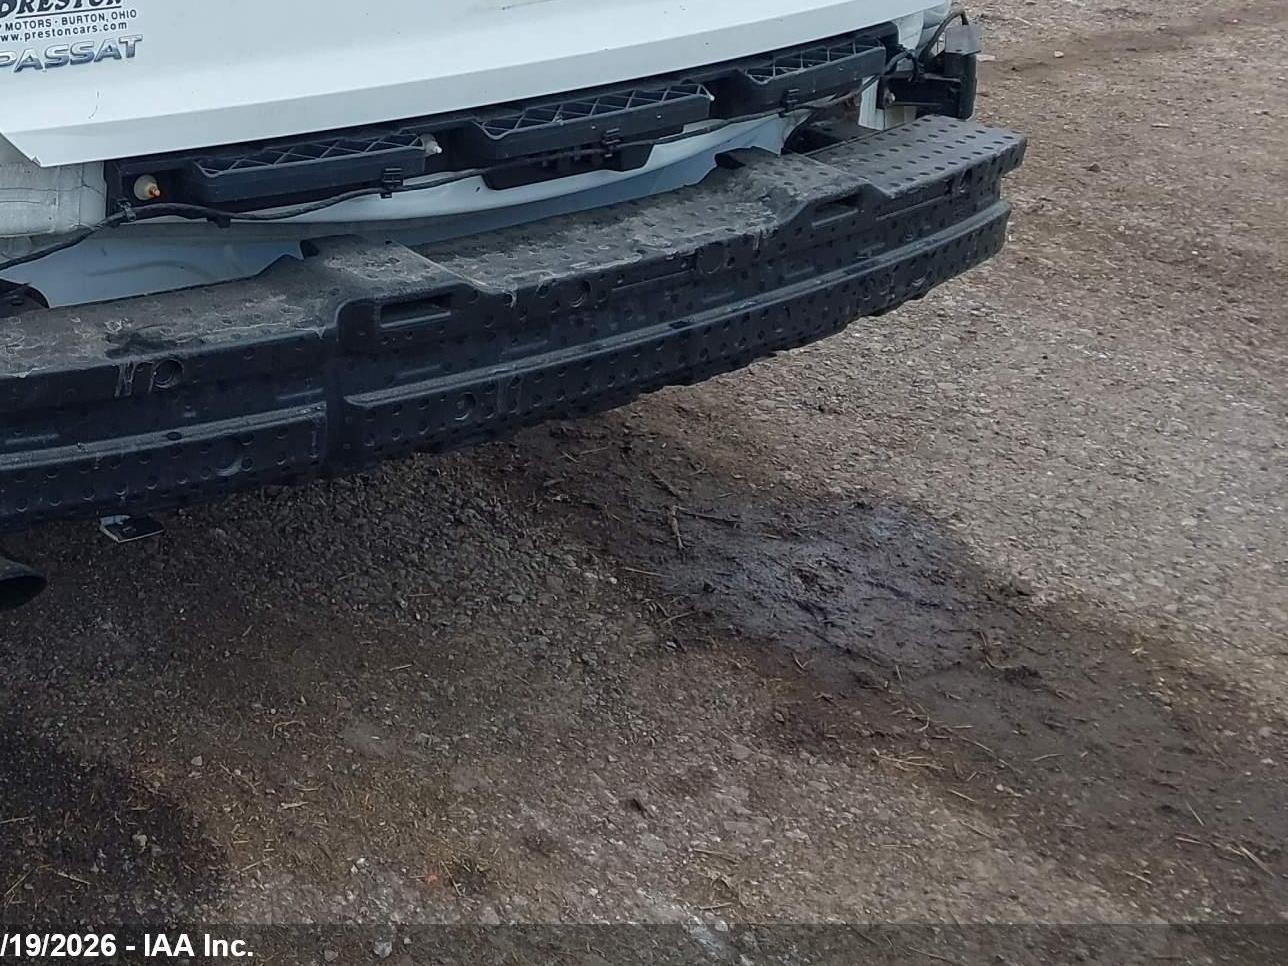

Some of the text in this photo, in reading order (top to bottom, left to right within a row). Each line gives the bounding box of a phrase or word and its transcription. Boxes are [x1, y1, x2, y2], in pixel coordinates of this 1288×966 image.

[4, 9, 137, 32] MOTORS BURTON, OHIO
